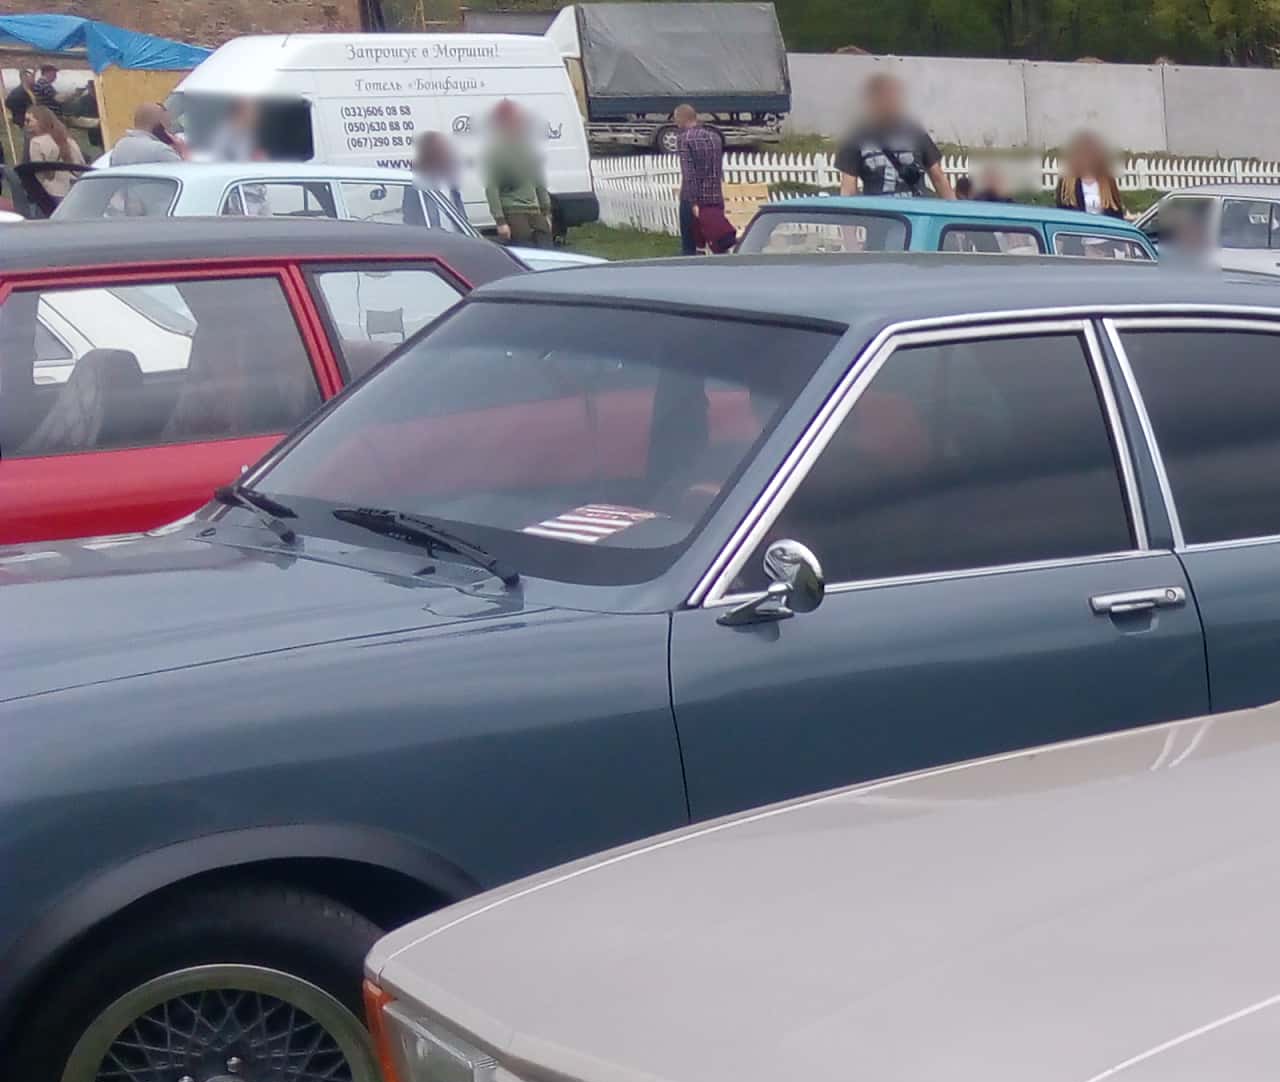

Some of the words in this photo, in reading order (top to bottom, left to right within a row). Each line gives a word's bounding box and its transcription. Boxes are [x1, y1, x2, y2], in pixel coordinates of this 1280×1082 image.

[345, 44, 417, 63] Запрошує
[422, 48, 429, 57] в
[432, 43, 499, 62] Моршин!
[354, 78, 402, 92] Готель
